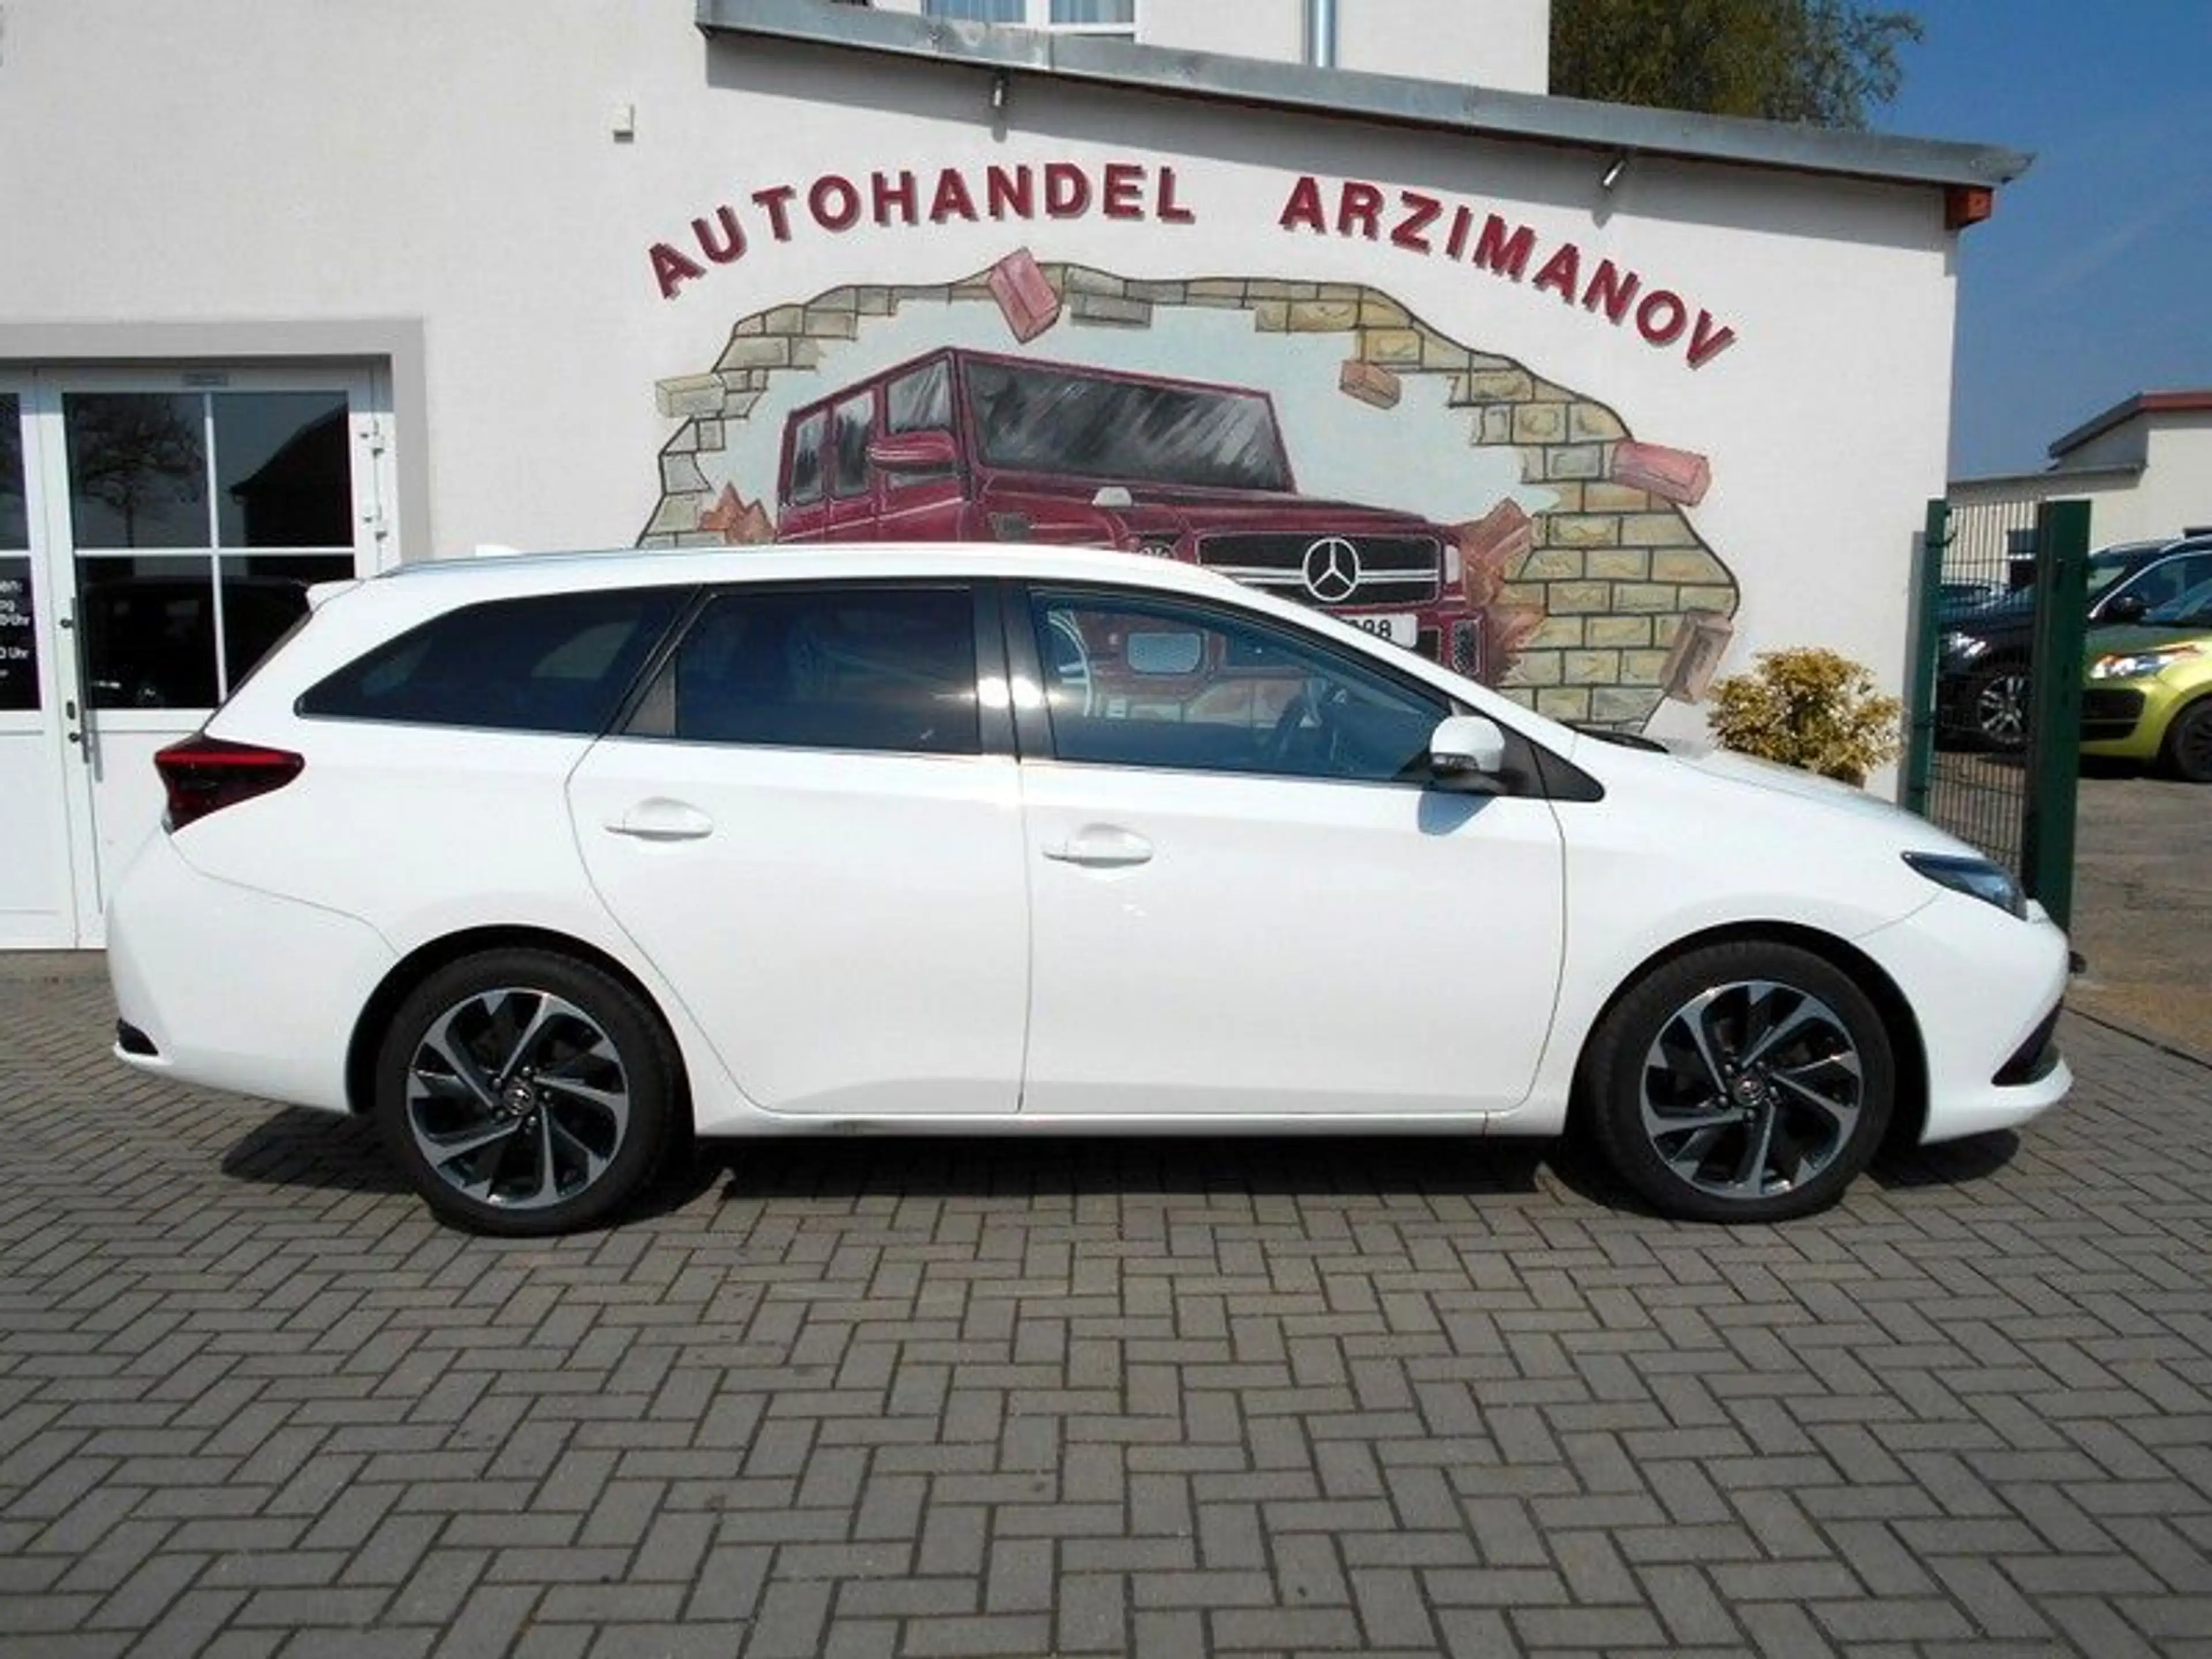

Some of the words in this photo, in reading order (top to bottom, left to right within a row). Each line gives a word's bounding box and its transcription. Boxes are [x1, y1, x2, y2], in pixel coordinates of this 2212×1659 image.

[647, 162, 1195, 300] AUTOHANDEL
[1278, 176, 1736, 370] ARZIMANOV
[8, 646, 29, 660] Uhr
